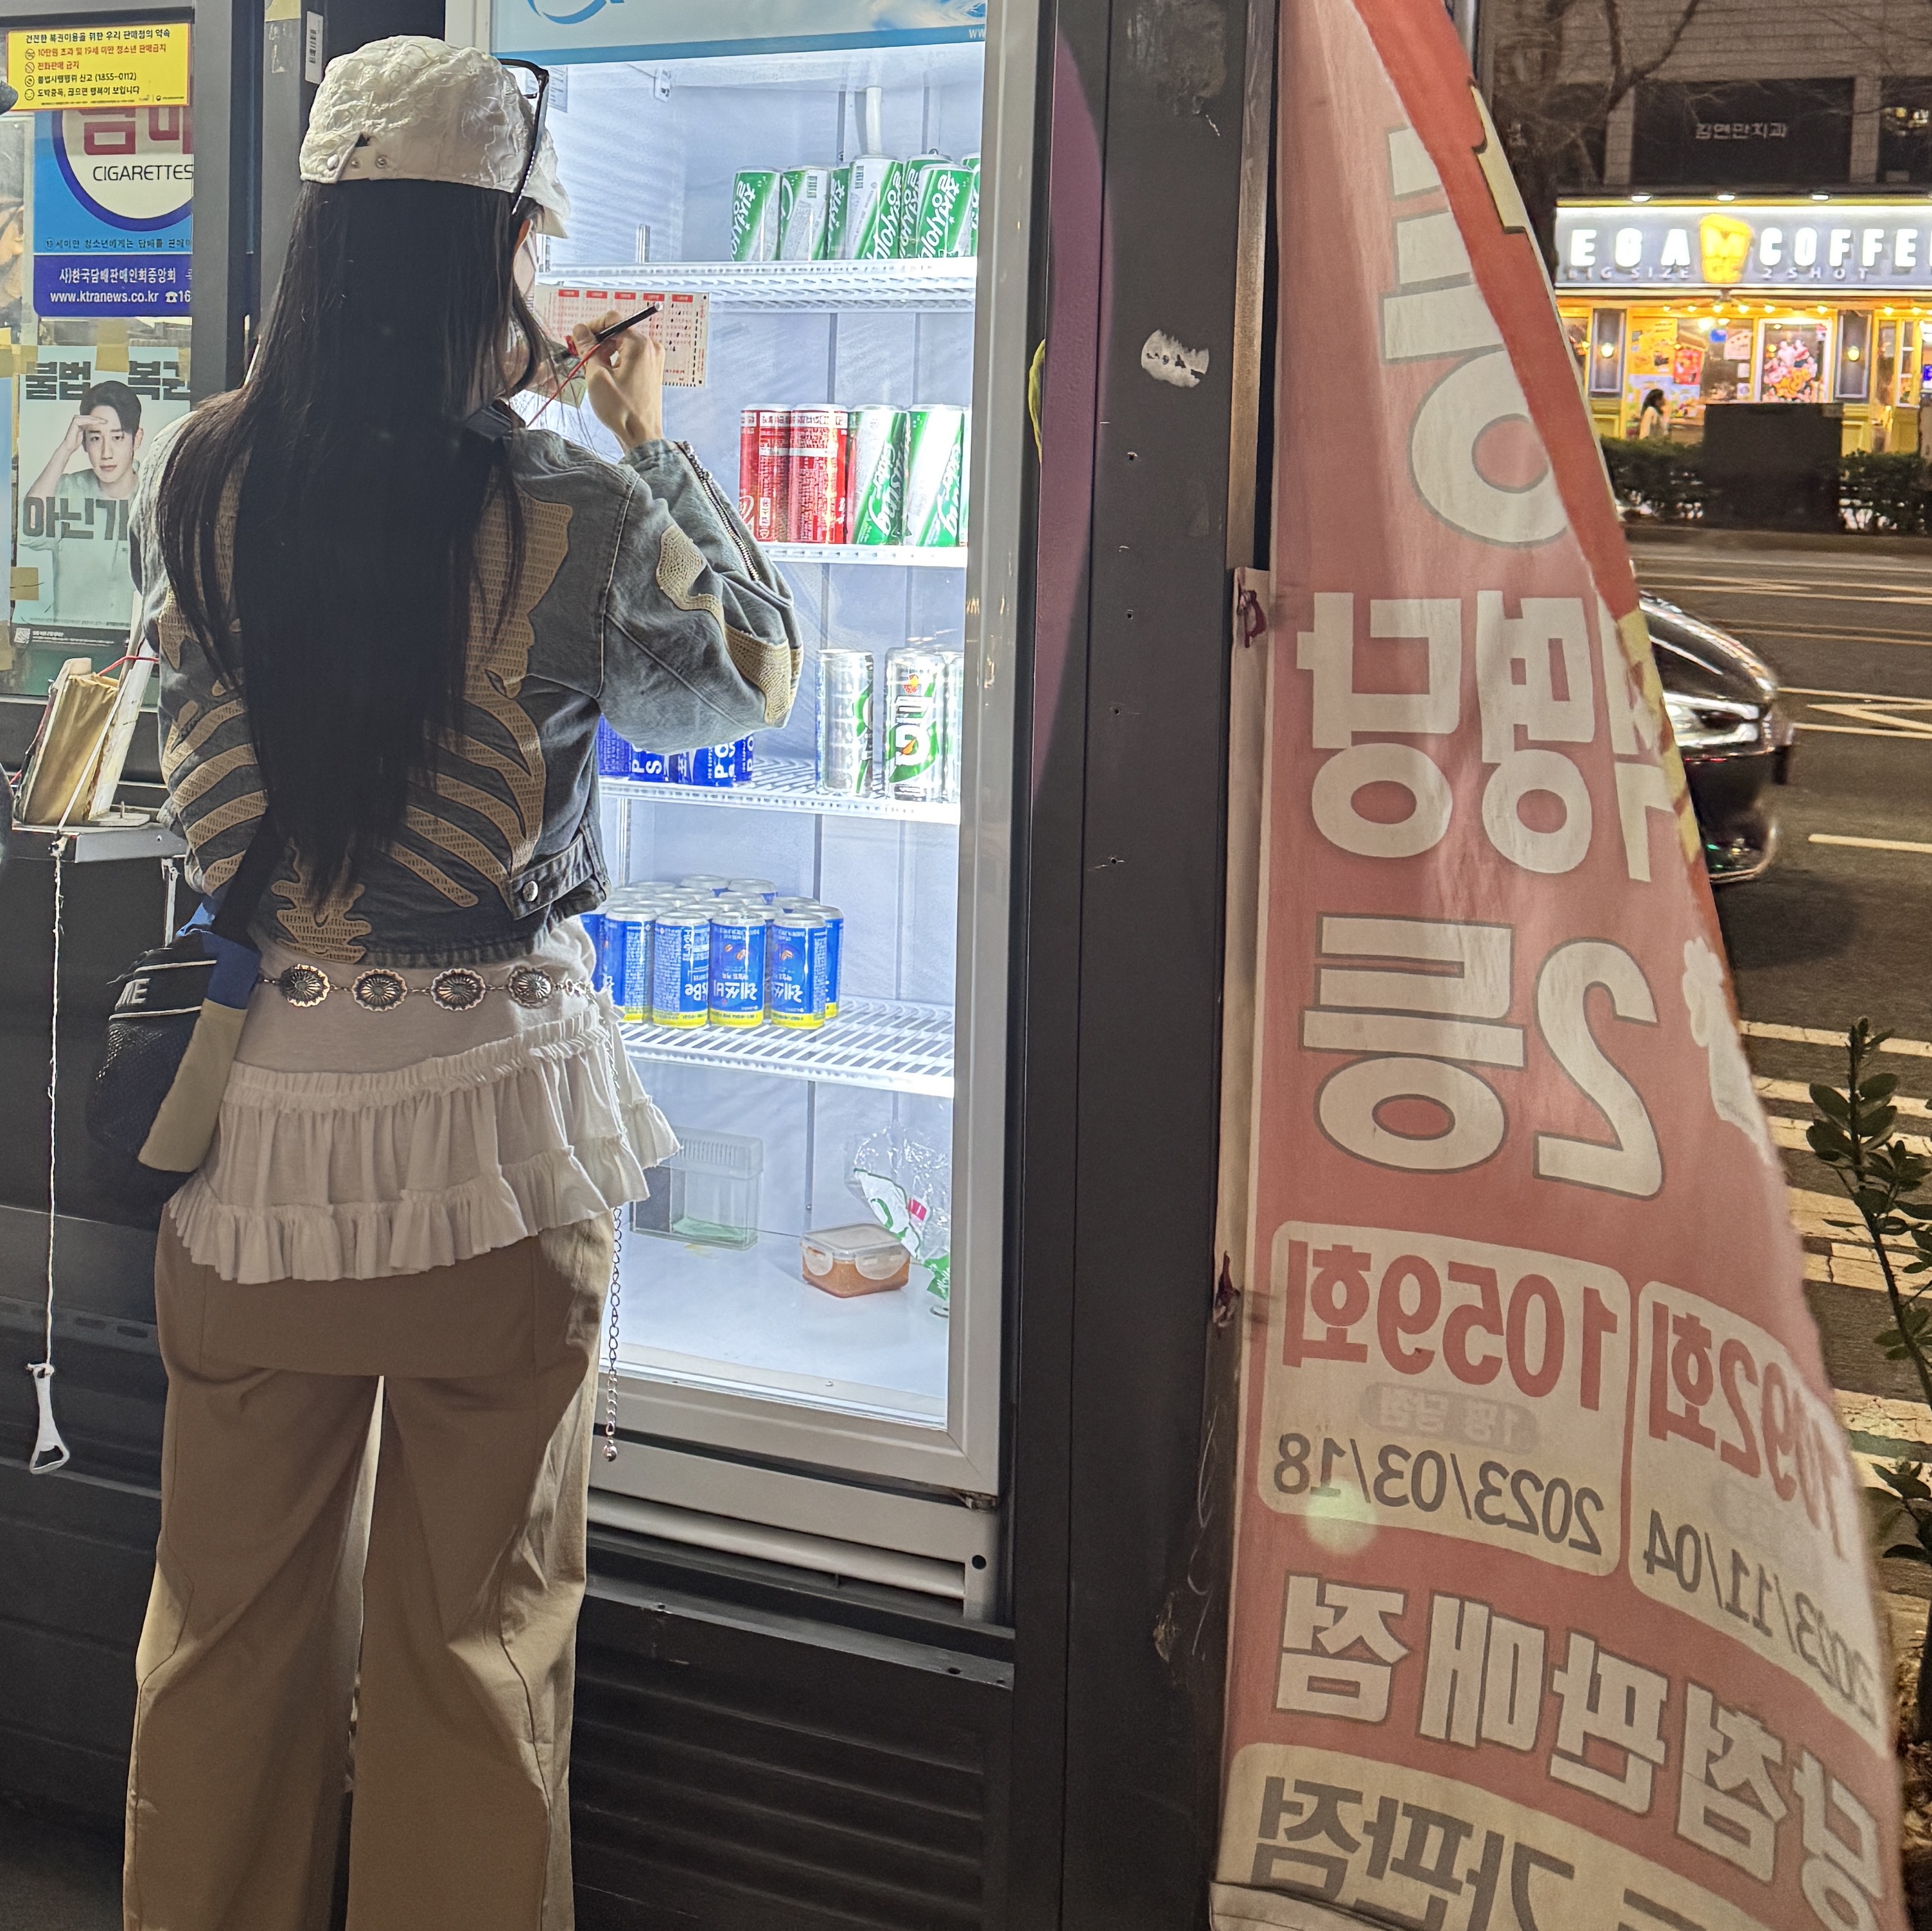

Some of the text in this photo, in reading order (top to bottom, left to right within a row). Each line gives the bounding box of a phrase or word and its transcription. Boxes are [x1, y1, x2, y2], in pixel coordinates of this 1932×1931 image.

[26, 28, 170, 44] 건전한 복권이용을 위한 우리 판매점의 약속
[38, 48, 58, 57] 10만원
[60, 48, 74, 56] 초과
[101, 46, 114, 55] 미만
[117, 44, 137, 54] 청소년
[139, 44, 166, 53] 판매금지
[37, 60, 80, 71] 전화판매 금지
[80, 74, 92, 82] 신고
[37, 85, 140, 98] 도박중독, 끊으면 행복이 보입니다
[92, 164, 193, 181] CIGARETTES
[731, 180, 755, 261] 칠성사이
[1759, 227, 1932, 268] COFFE
[1630, 266, 1690, 280] SIZE
[50, 290, 159, 303] www.ktranews.co.kr
[713, 979, 758, 1001] 레쓰비
[771, 981, 804, 1004] 레쓰
